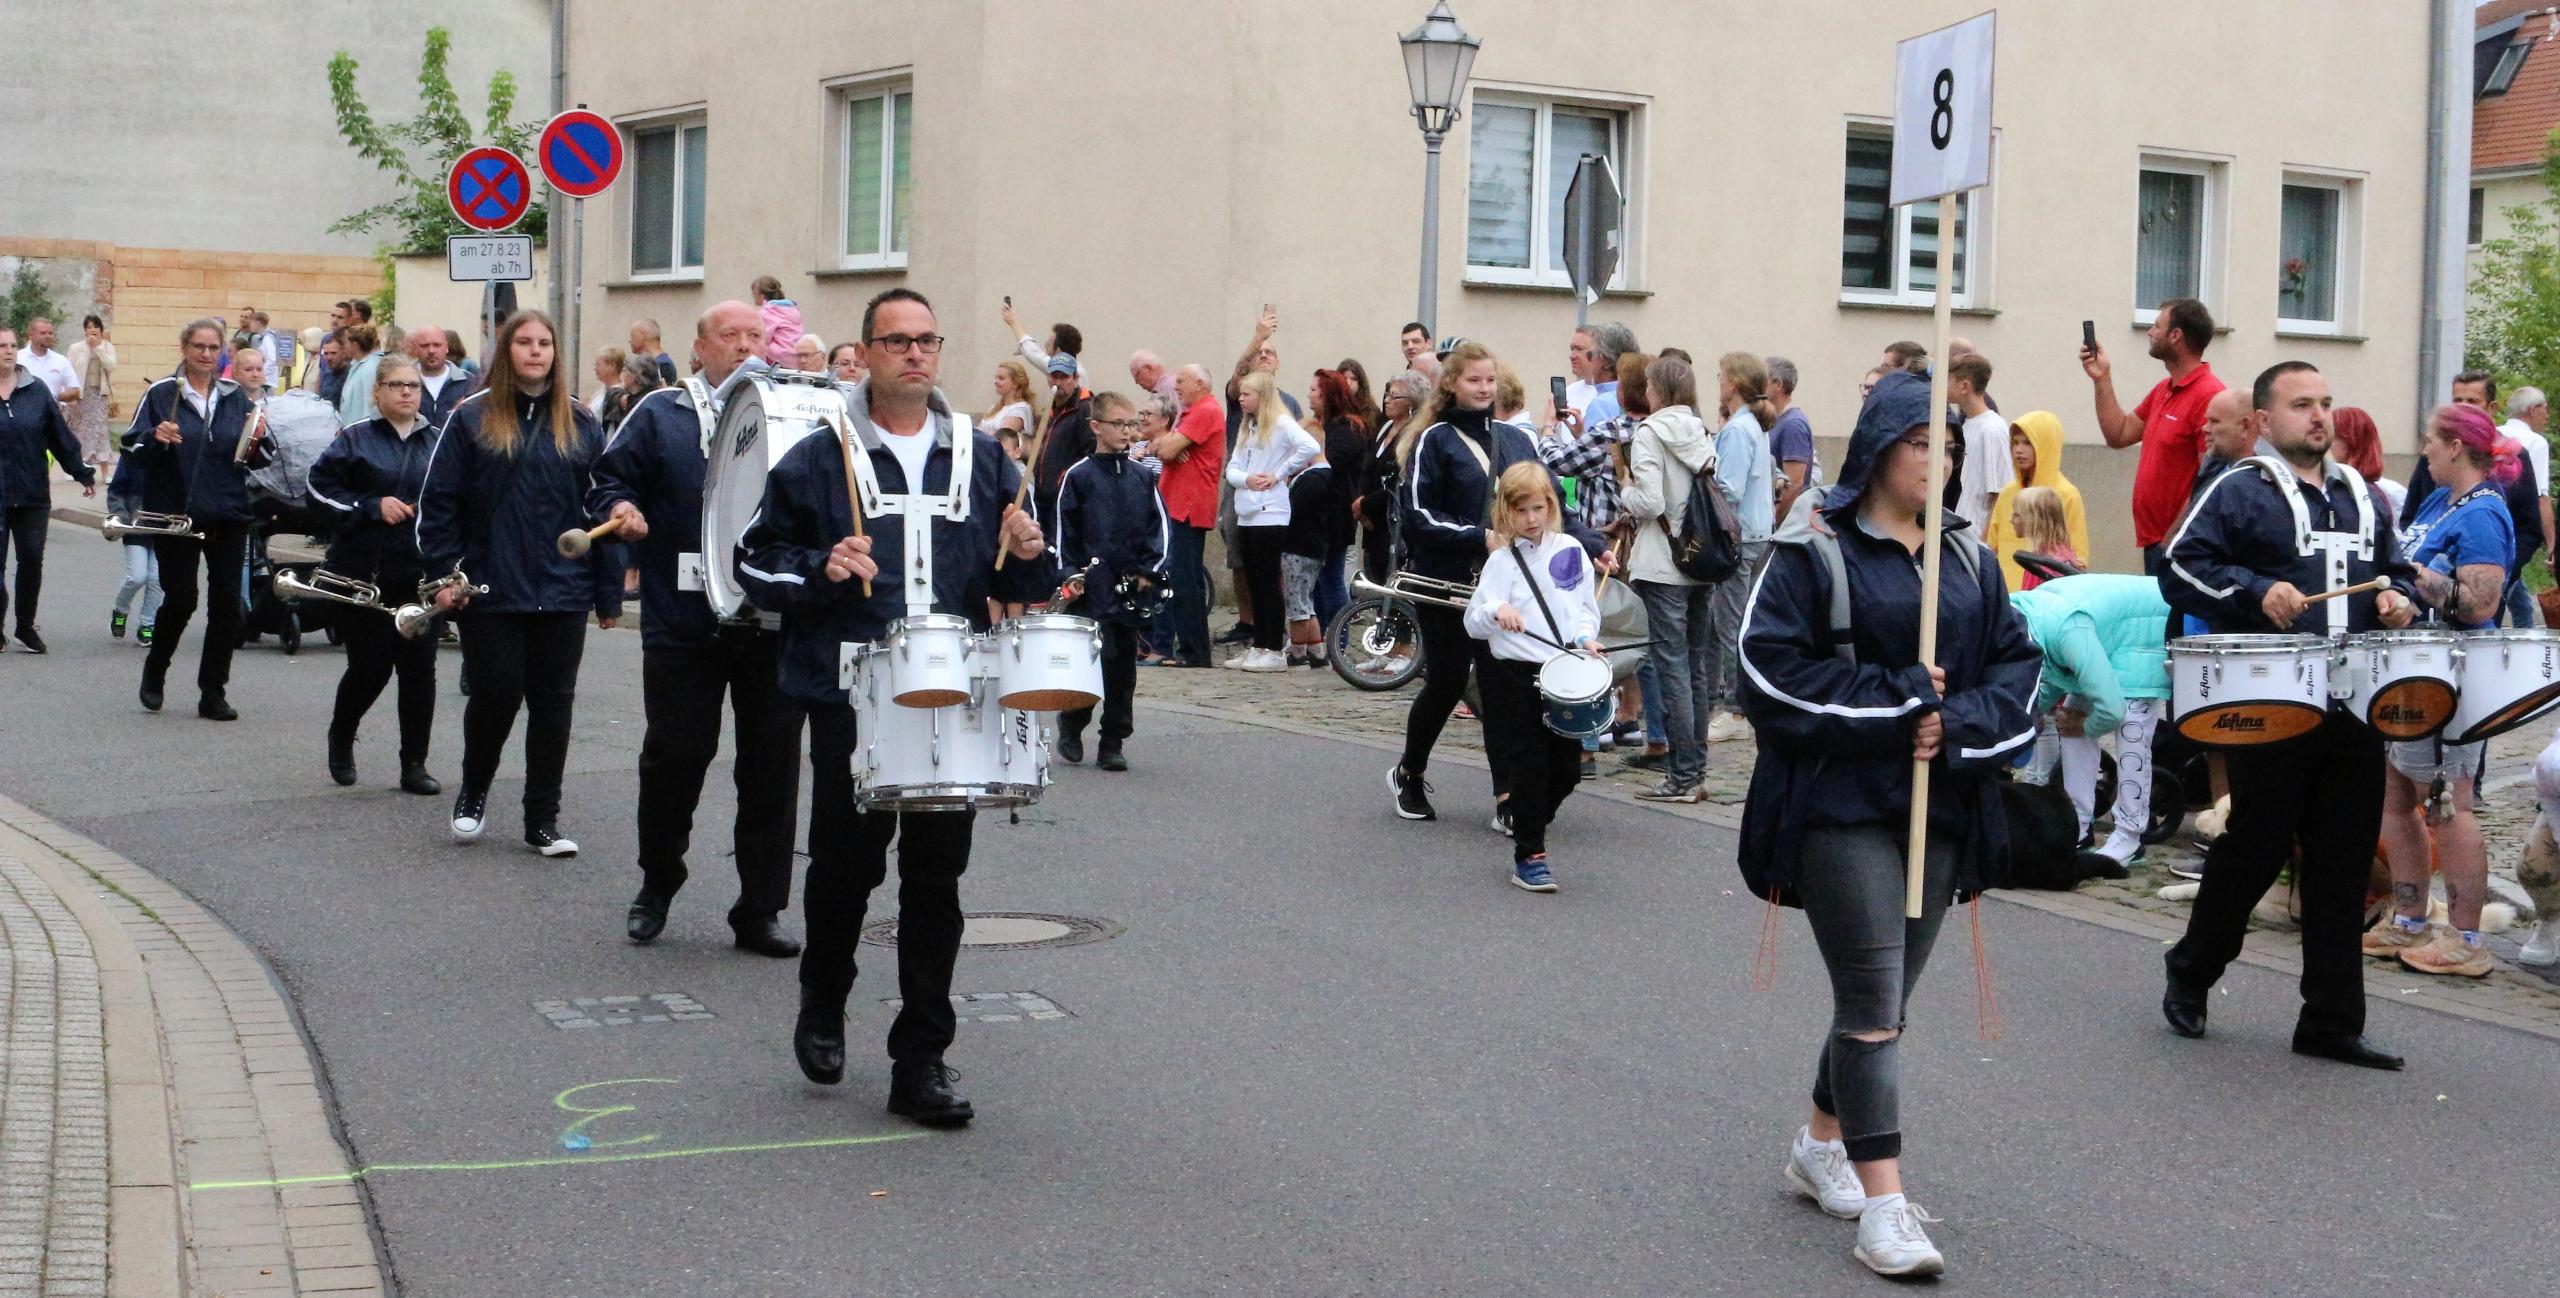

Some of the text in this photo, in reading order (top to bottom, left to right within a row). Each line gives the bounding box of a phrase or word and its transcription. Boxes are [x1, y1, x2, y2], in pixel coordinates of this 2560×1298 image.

[1931, 68, 1953, 150] 8
[460, 243, 521, 257] am 27.8.23
[491, 260, 521, 274] ab 7h
